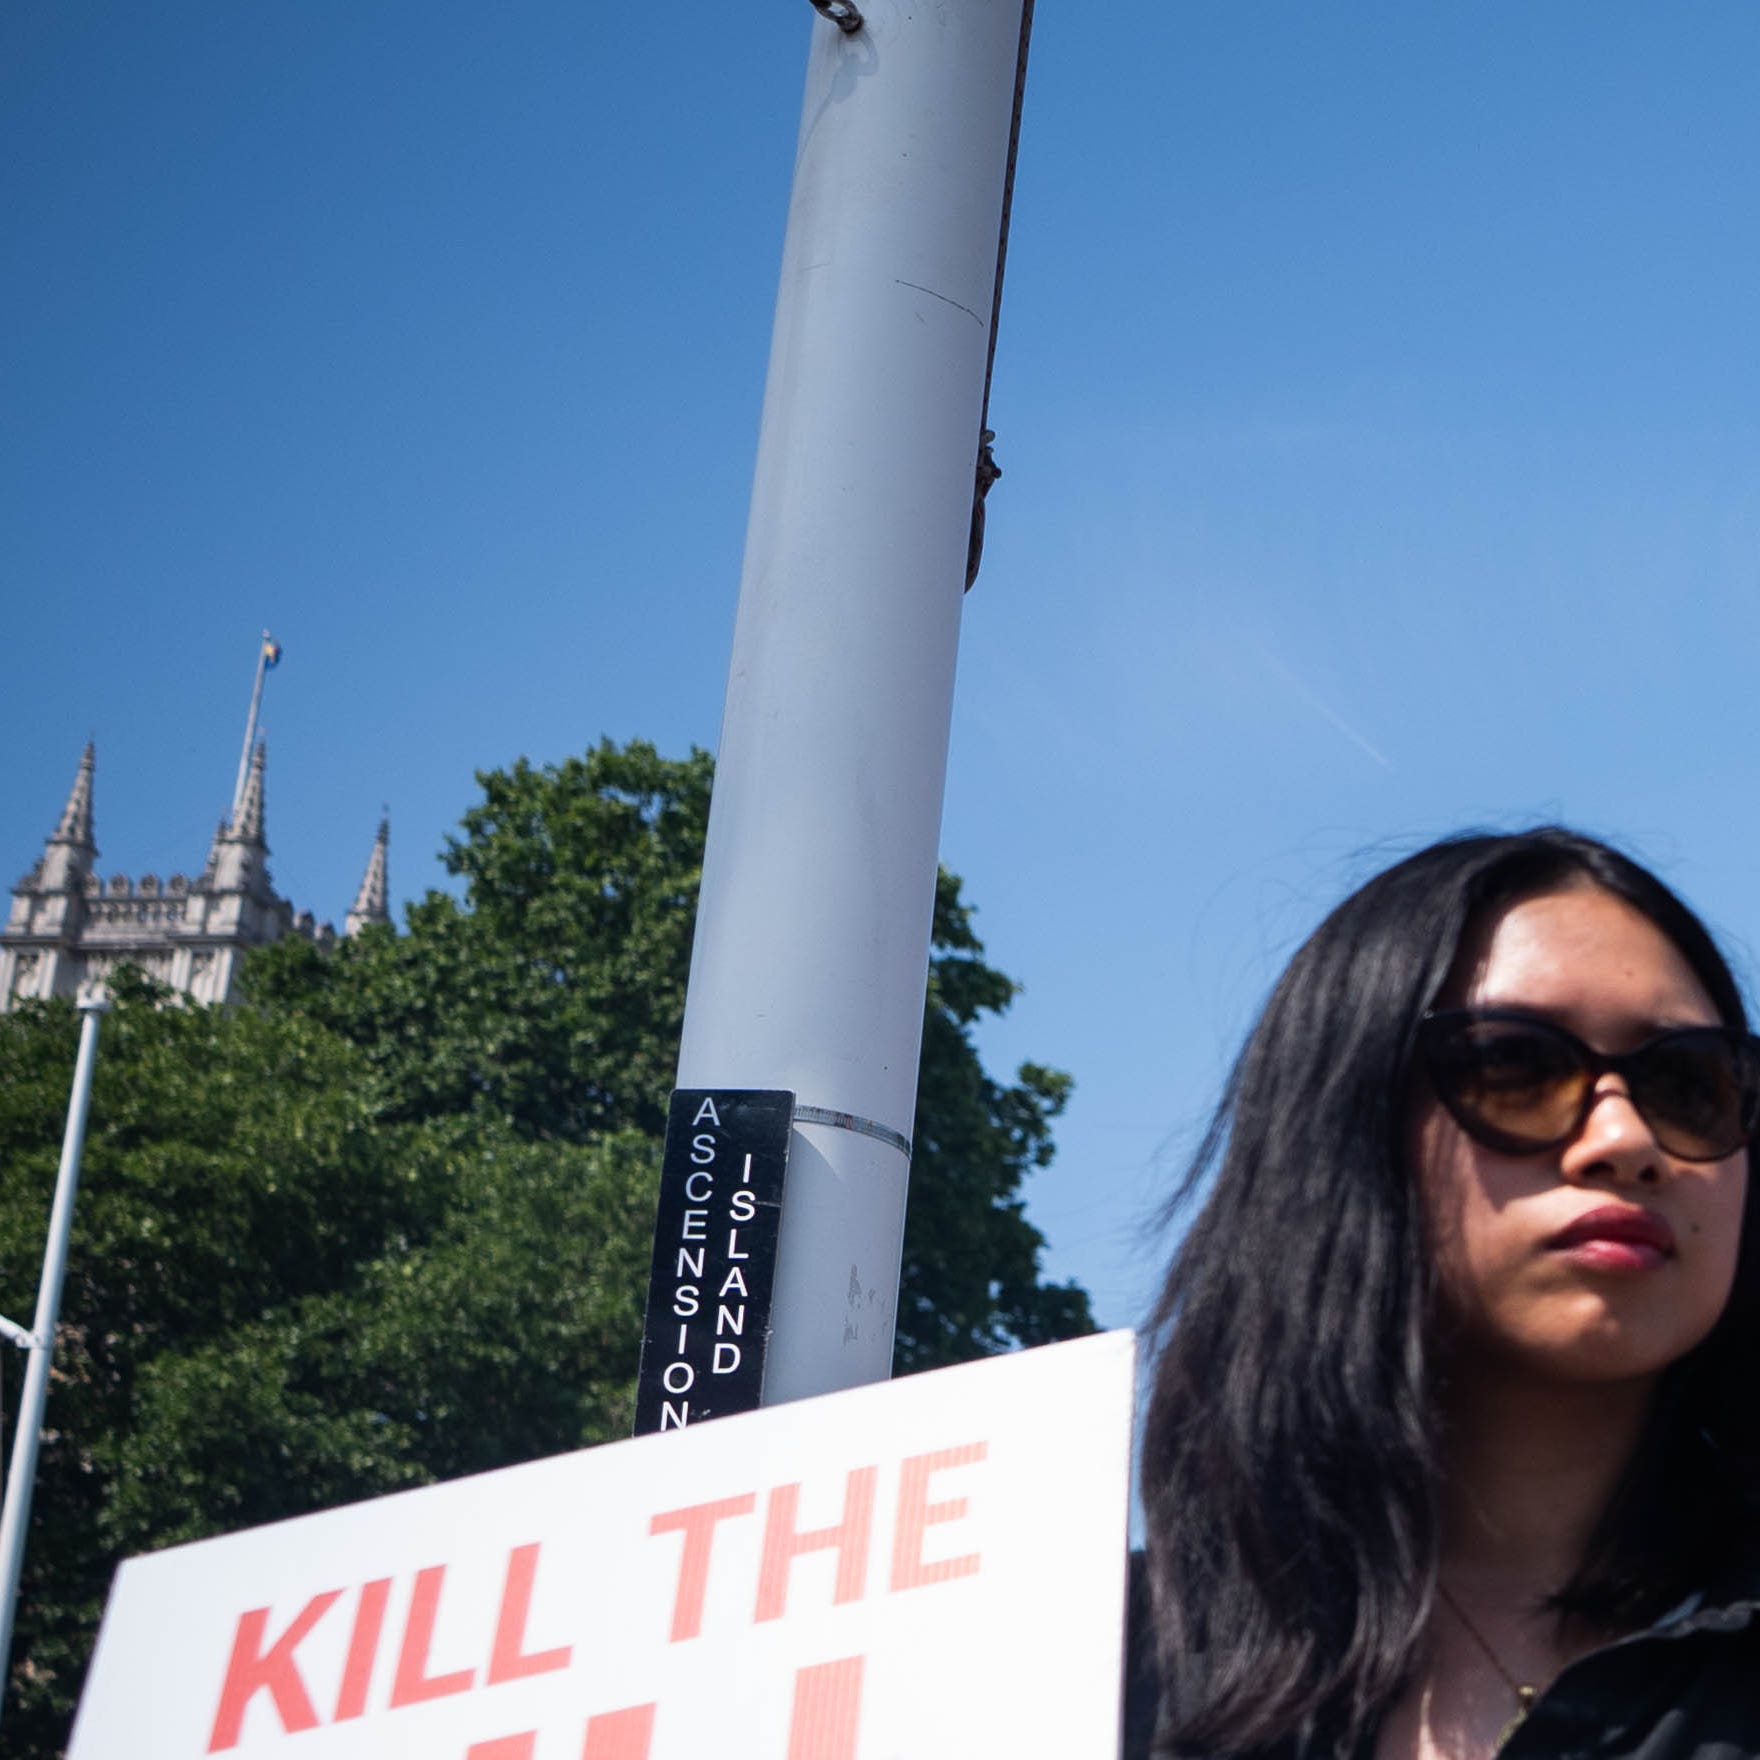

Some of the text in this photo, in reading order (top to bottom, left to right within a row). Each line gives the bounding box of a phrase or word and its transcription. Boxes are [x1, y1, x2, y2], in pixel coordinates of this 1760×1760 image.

[660, 1097, 721, 1431] ASCENSION
[712, 1153, 756, 1374] ISLAND
[207, 1438, 991, 1755] KILL THE
